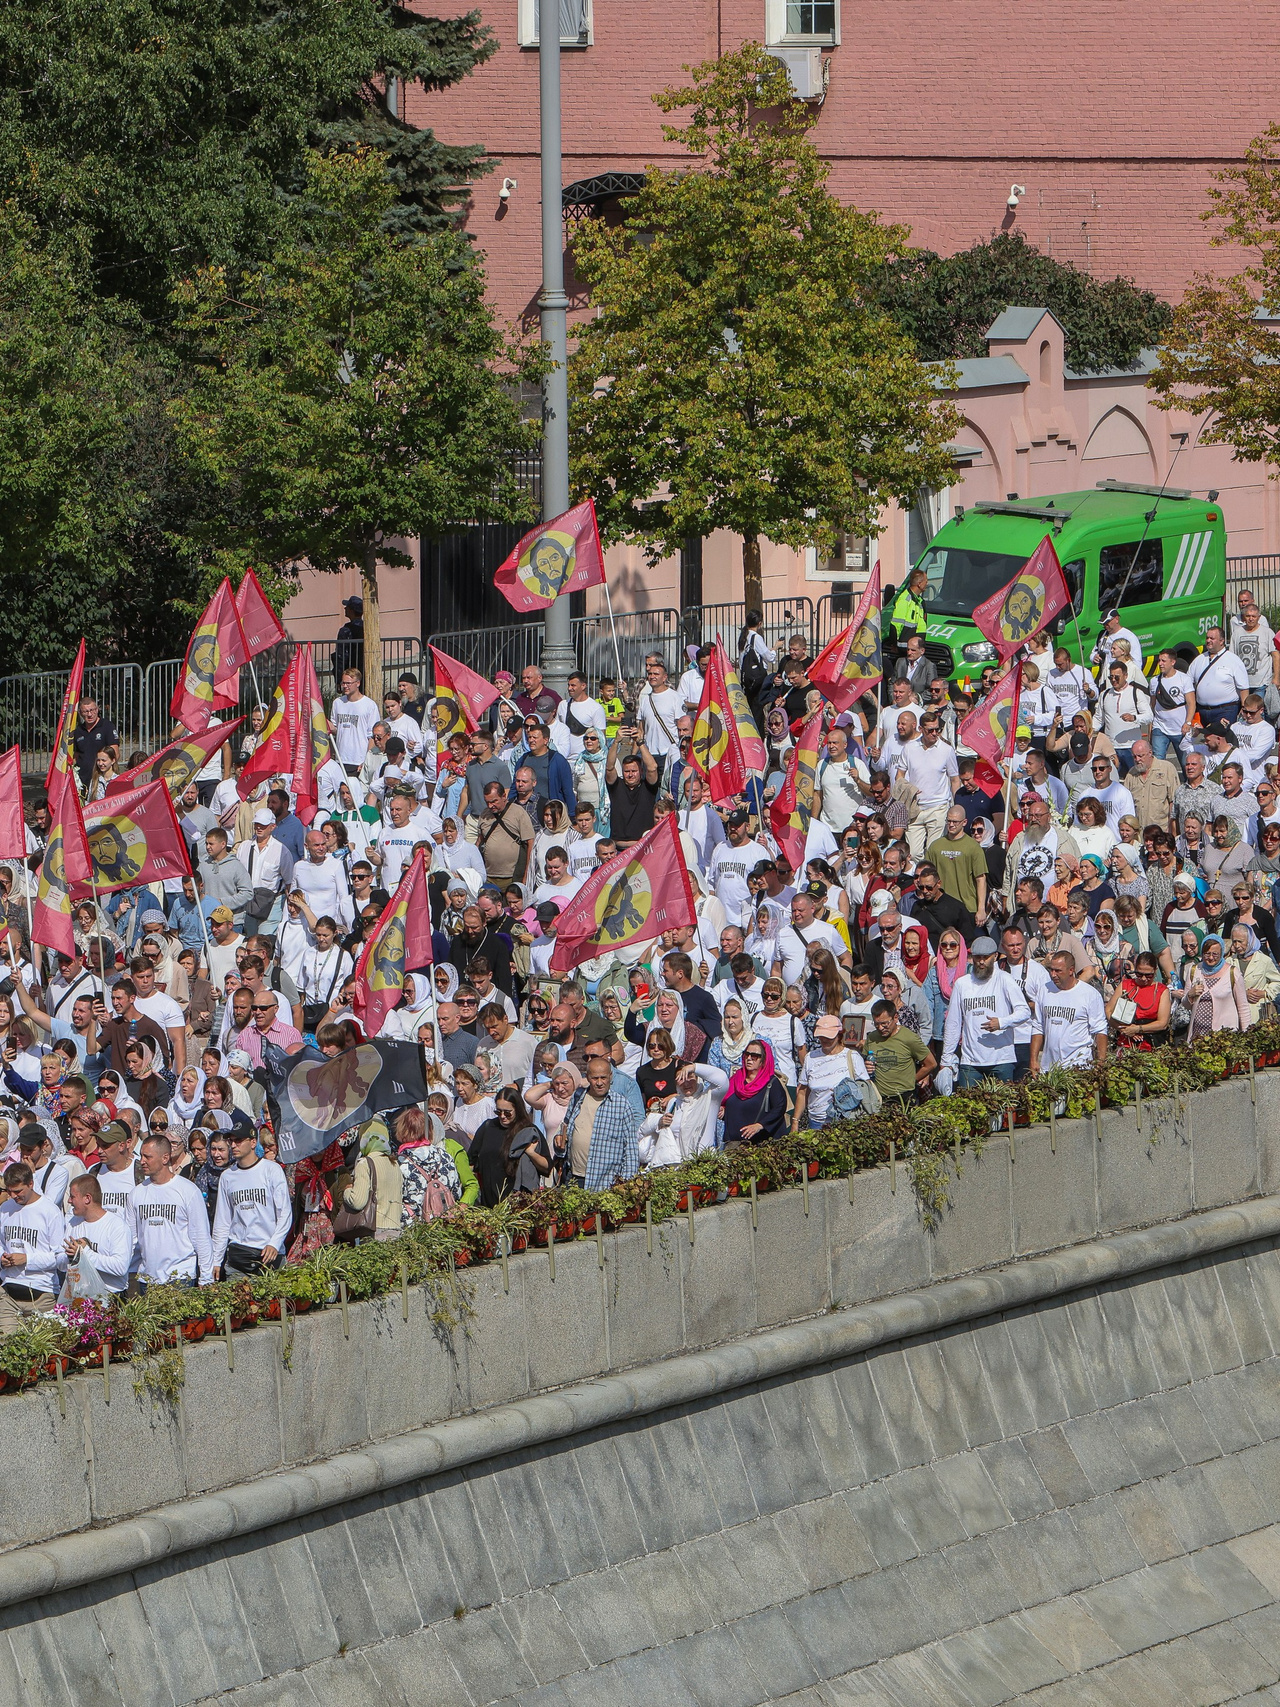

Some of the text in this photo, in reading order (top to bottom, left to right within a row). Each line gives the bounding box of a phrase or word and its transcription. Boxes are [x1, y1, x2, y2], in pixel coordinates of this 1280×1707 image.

[926, 624, 957, 640] ДД
[1198, 615, 1218, 635] 568
[102, 1192, 129, 1208] ССКА
